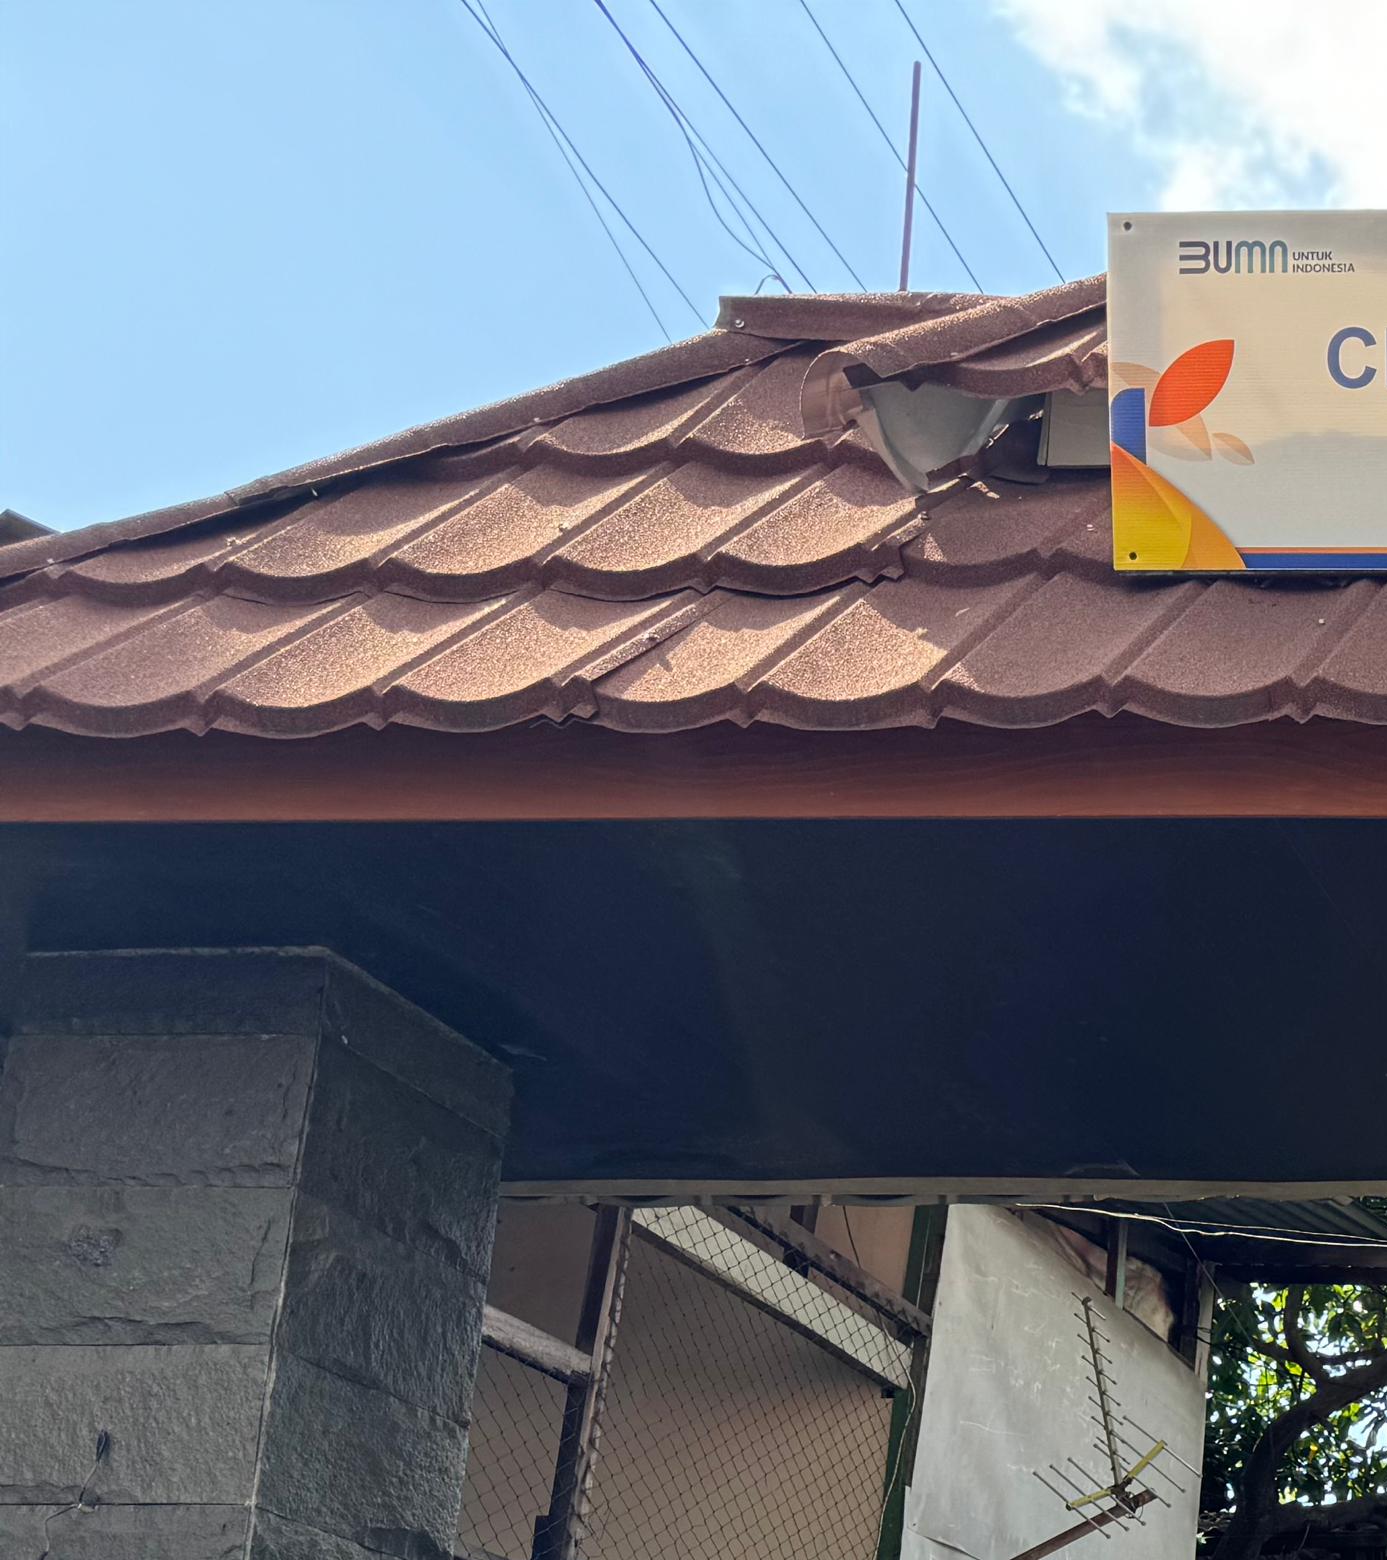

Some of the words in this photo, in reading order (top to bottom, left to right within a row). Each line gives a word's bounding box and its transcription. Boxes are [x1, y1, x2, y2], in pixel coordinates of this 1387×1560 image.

[1179, 240, 1288, 274] BUMN
[1292, 250, 1333, 262] UNTUK
[1292, 262, 1355, 273] INDONESIA
